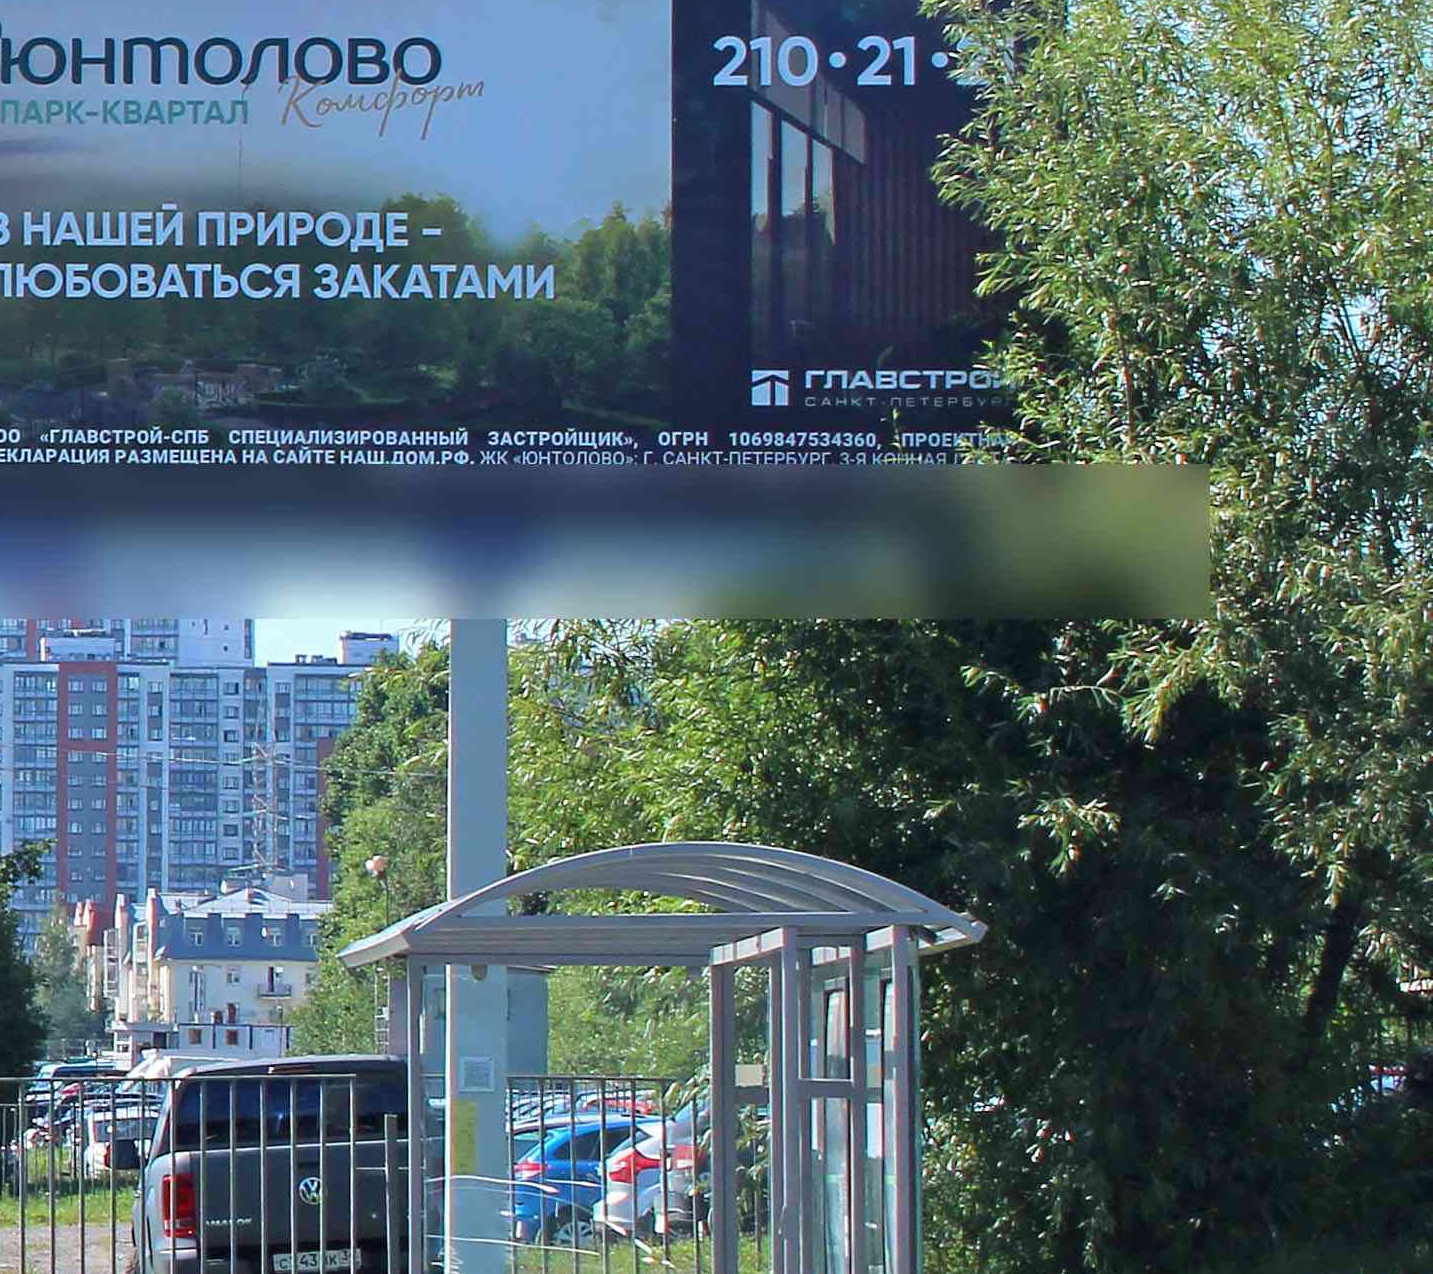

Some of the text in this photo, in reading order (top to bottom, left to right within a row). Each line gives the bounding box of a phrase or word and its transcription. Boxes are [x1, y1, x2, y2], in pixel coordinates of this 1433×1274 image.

[0, 37, 442, 86] ЮНТОЛОВО
[713, 35, 819, 87] 210
[0, 98, 249, 126] ПАРК-КВАРТАЛ
[278, 70, 484, 141] Комфорт
[22, 203, 184, 247] НАШЕЙ
[199, 212, 409, 253] ПРИРОДЕ
[313, 263, 556, 299] ЗАКАТАМИ
[40, 426, 209, 445] «ГЛАВСТРОЙ-СПБ
[228, 427, 468, 448] СПЕЦИАЛИЗИРОВАННЫЙ
[488, 428, 638, 449] ЗАСТРОЙЩИК»,
[658, 431, 709, 446] ОГРН
[728, 432, 882, 450] 1069847534360,
[115, 449, 237, 466] РАЗМЕЩЕНА
[242, 449, 267, 464] НА
[273, 446, 336, 465] САЙТЕ
[340, 449, 475, 466] НАШ.ДОМ.РФ.
[480, 451, 509, 465] ЖК
